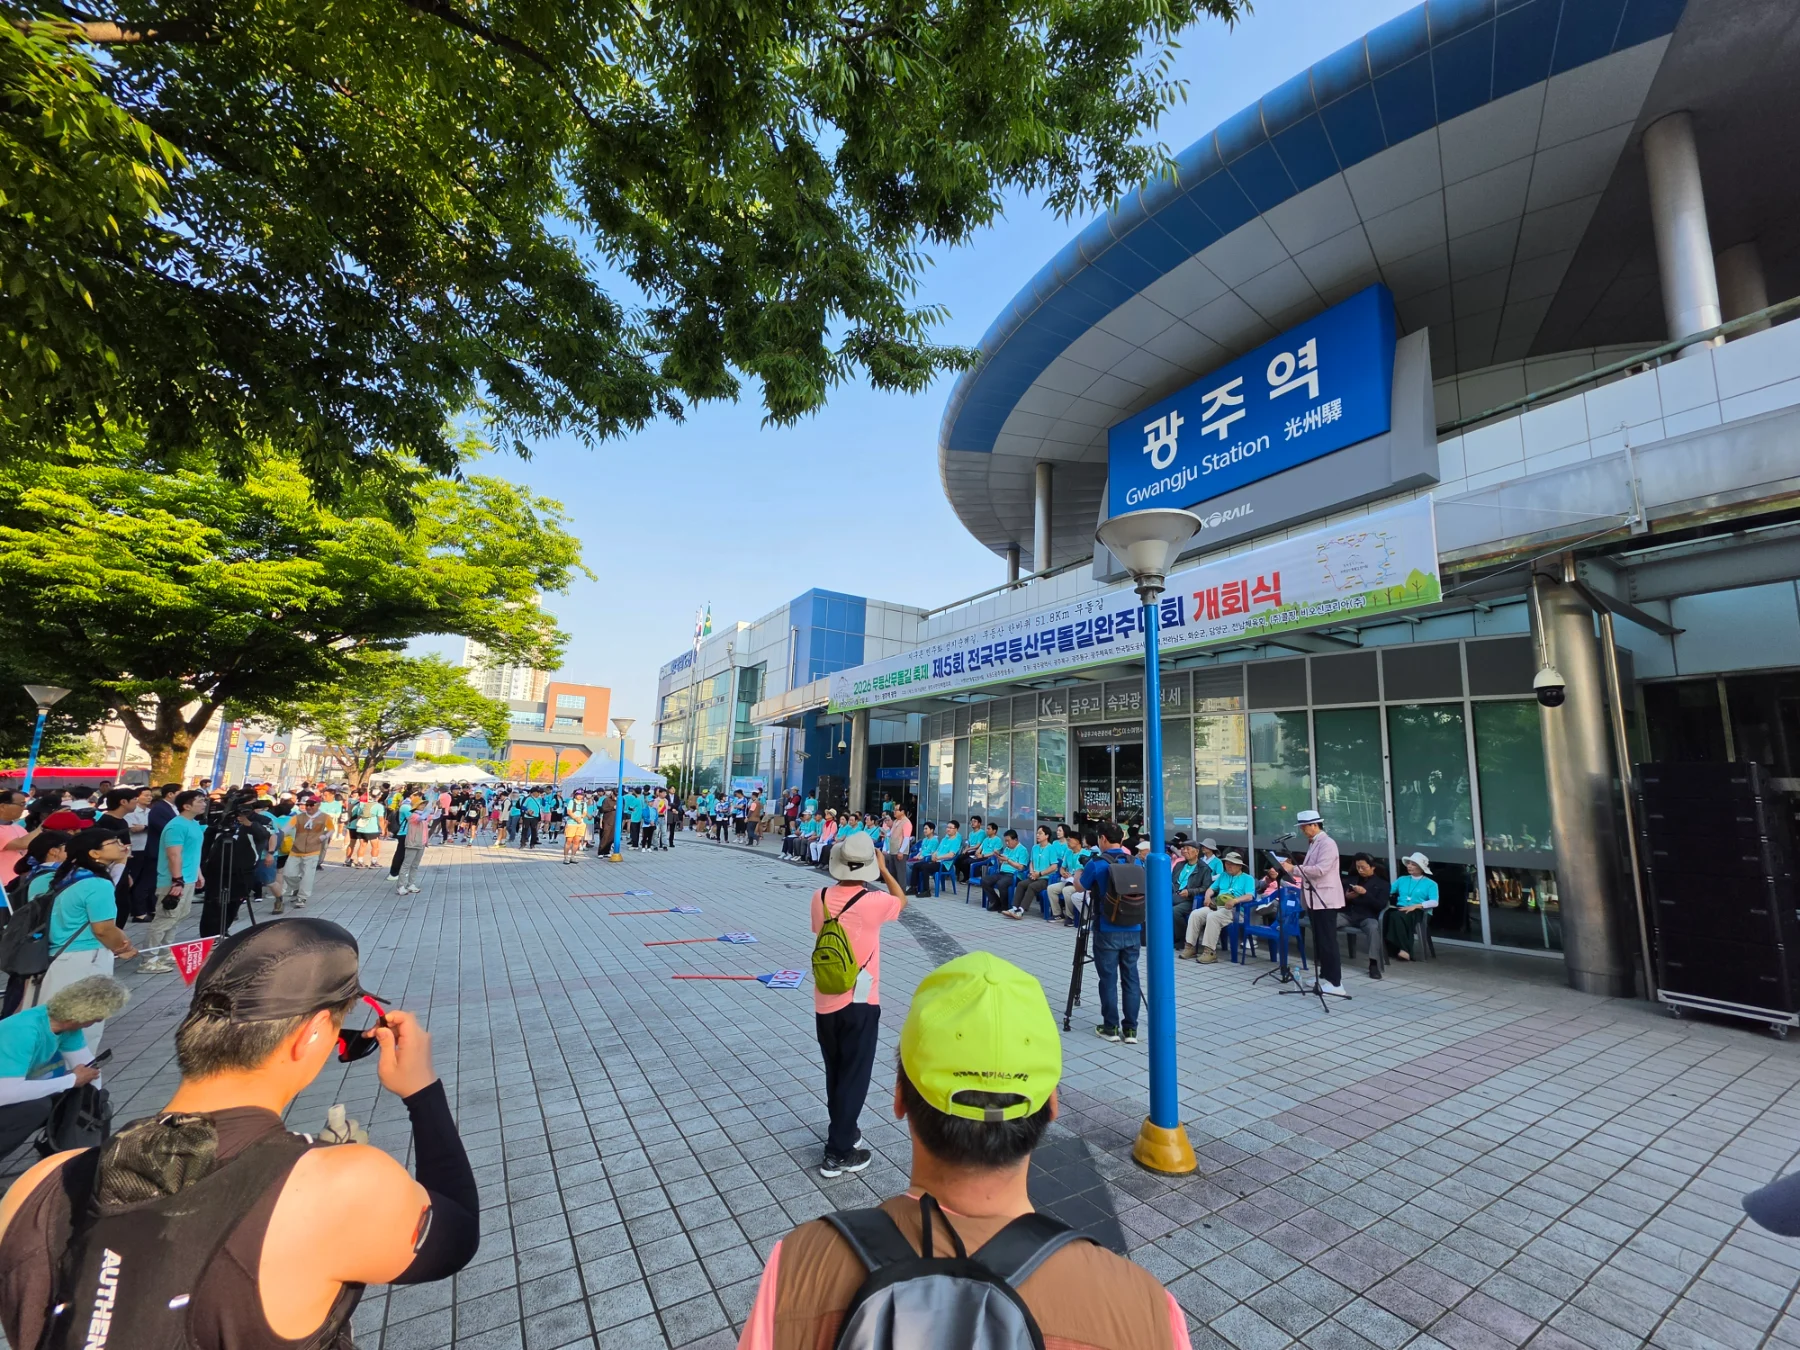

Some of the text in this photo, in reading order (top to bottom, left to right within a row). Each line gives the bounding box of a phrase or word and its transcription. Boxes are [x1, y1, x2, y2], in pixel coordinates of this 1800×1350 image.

[1284, 398, 1342, 442] 光州驛
[1126, 433, 1270, 506] Gwangju Station
[1201, 503, 1254, 530] KORAIL
[932, 651, 965, 679] 제5회
[1193, 571, 1283, 622] 개회식
[982, 626, 1005, 640] 무등산
[1035, 606, 1070, 626] 51.8Km
[1075, 598, 1104, 615] 무돌길
[1187, 629, 1208, 639] 화순군,
[853, 680, 872, 695] 2026
[872, 668, 912, 691] 무등산무돌길
[913, 664, 929, 681] 축제
